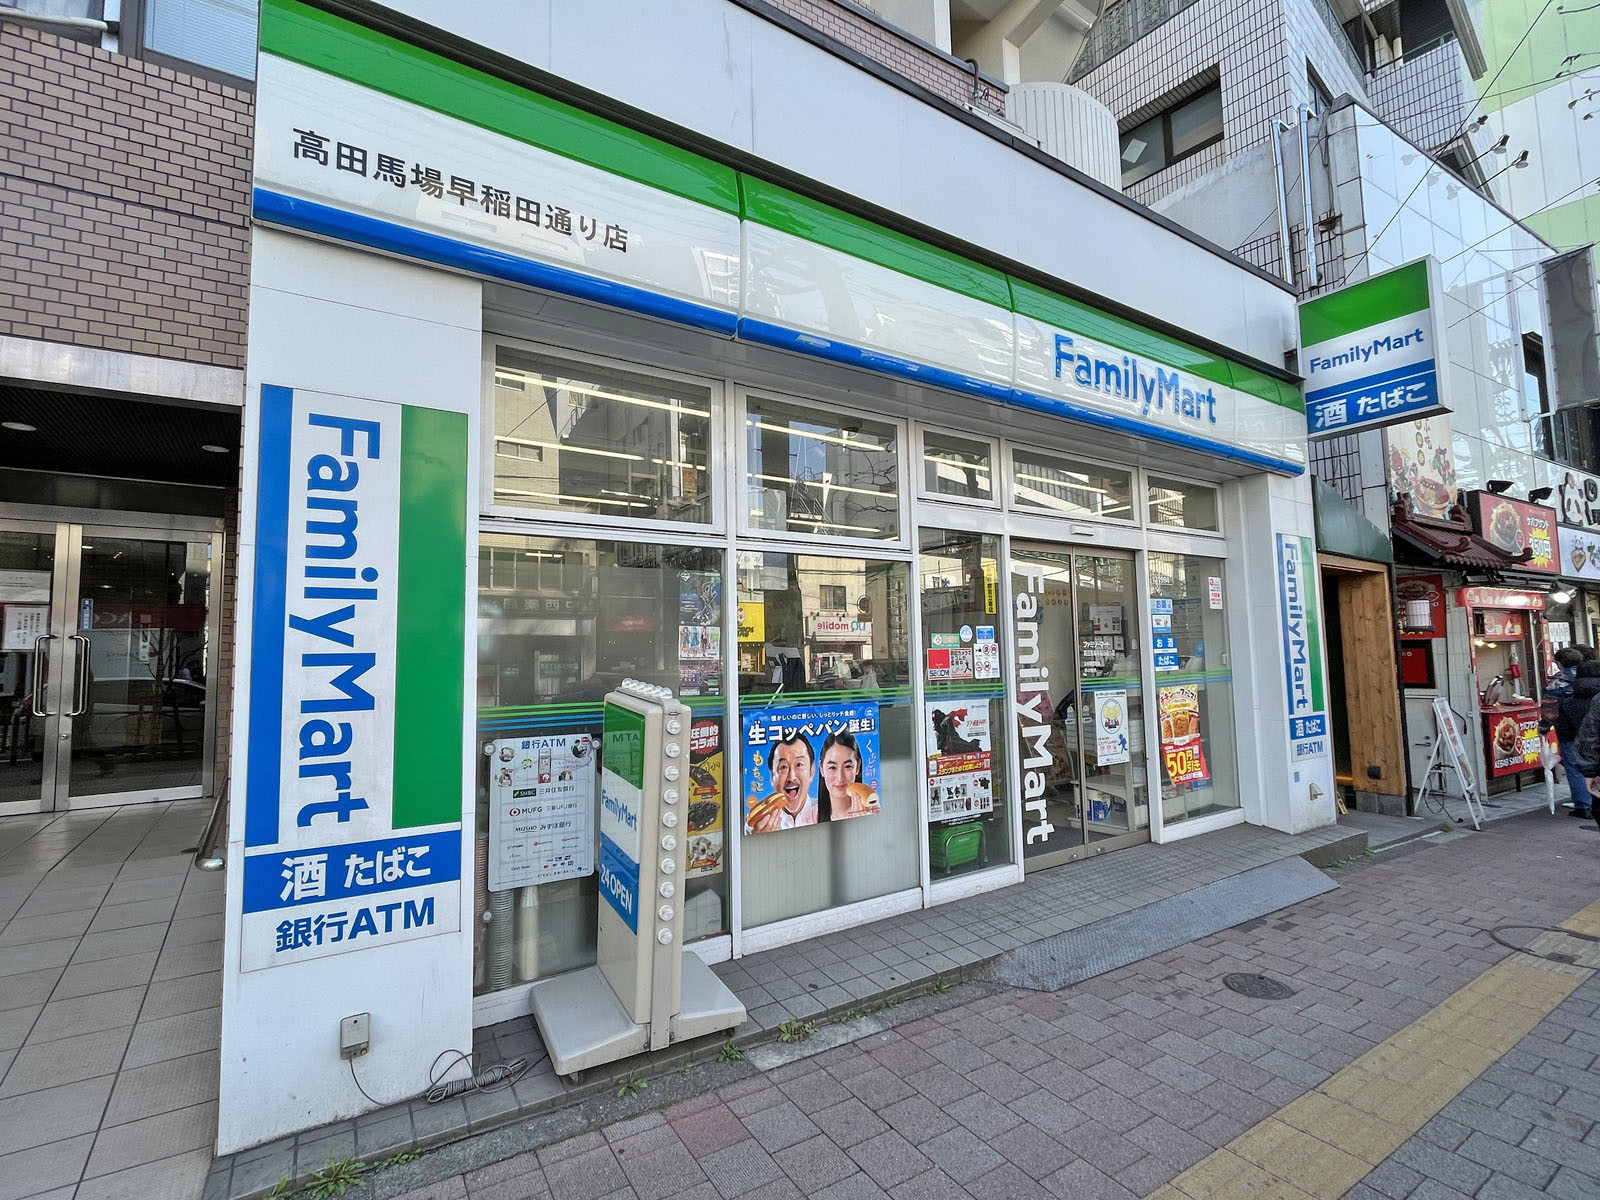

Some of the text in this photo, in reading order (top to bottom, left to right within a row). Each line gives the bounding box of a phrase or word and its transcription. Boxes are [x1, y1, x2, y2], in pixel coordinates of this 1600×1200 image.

[292, 128, 629, 254] 高田馬場早稲田通り店
[1309, 328, 1425, 374] FamilyMart
[1054, 333, 1217, 424] FamilyMart
[1315, 381, 1429, 428] 酒 たばこ
[288, 412, 381, 828] FamilyMart
[1284, 543, 1309, 710] FamilyMart
[929, 669, 950, 677] SECOM
[1158, 655, 1175, 666] たばこ
[1014, 565, 1055, 845] FamilyMart
[521, 738, 567, 750] 銀行ATM
[690, 736, 719, 751] コラボ!
[521, 807, 543, 815] MUFG
[601, 788, 638, 832] FamilyMart
[279, 845, 433, 902] 酒 たばこ
[275, 896, 435, 952] 銀行ATM
